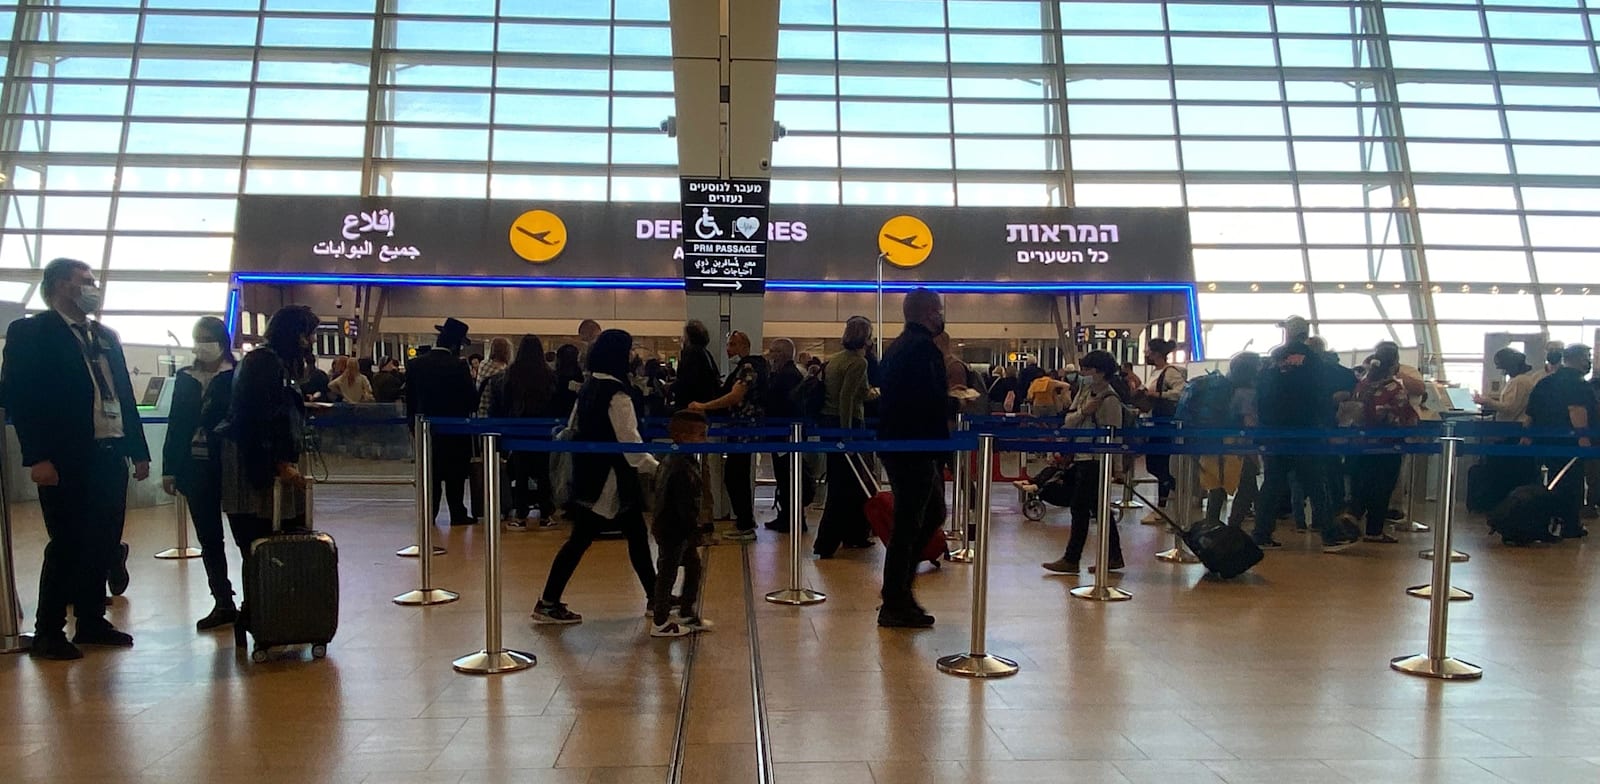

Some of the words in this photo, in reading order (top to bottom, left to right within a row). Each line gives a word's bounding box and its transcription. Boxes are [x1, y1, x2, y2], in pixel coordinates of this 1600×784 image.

[689, 182, 731, 192] לנוסעים
[733, 183, 762, 193] מעבר
[708, 194, 743, 204] נעזרים
[342, 208, 395, 240] إقلاع
[1006, 224, 1119, 243] המראות
[313, 239, 373, 259] البوابات
[378, 243, 421, 262] جميع
[694, 243, 714, 252] PRM
[715, 244, 757, 254] PASSAGE
[1087, 247, 1109, 263] כל
[1017, 250, 1084, 264] השערים
